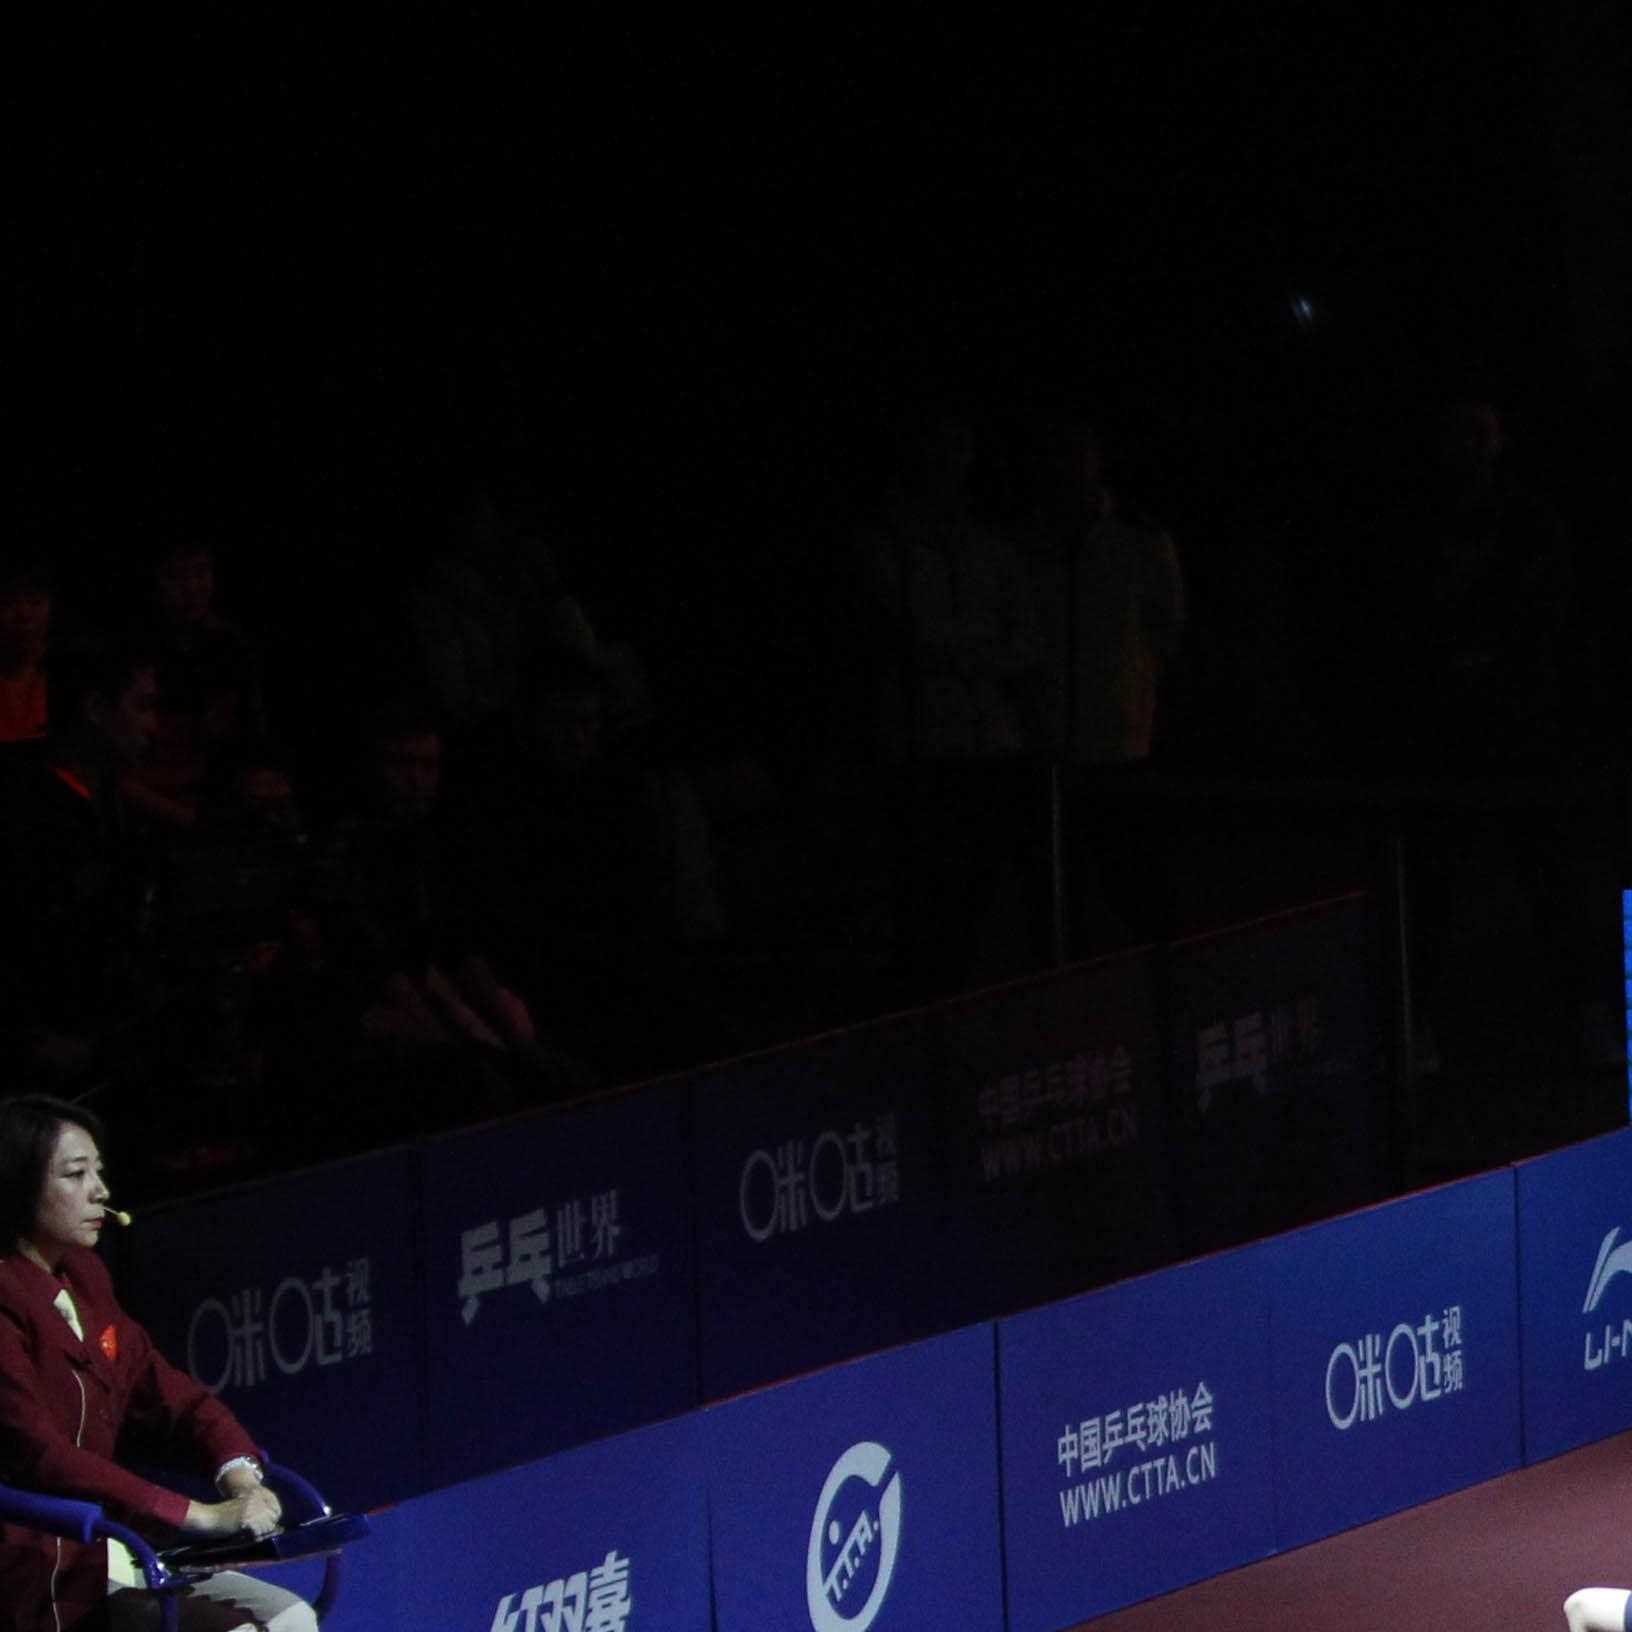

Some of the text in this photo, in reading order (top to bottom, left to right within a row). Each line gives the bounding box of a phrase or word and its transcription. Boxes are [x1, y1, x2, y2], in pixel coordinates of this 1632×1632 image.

[1056, 1380, 1214, 1479] 中国乒乓球协会
[1059, 1439, 1218, 1528] WWW.CTTA.CN
